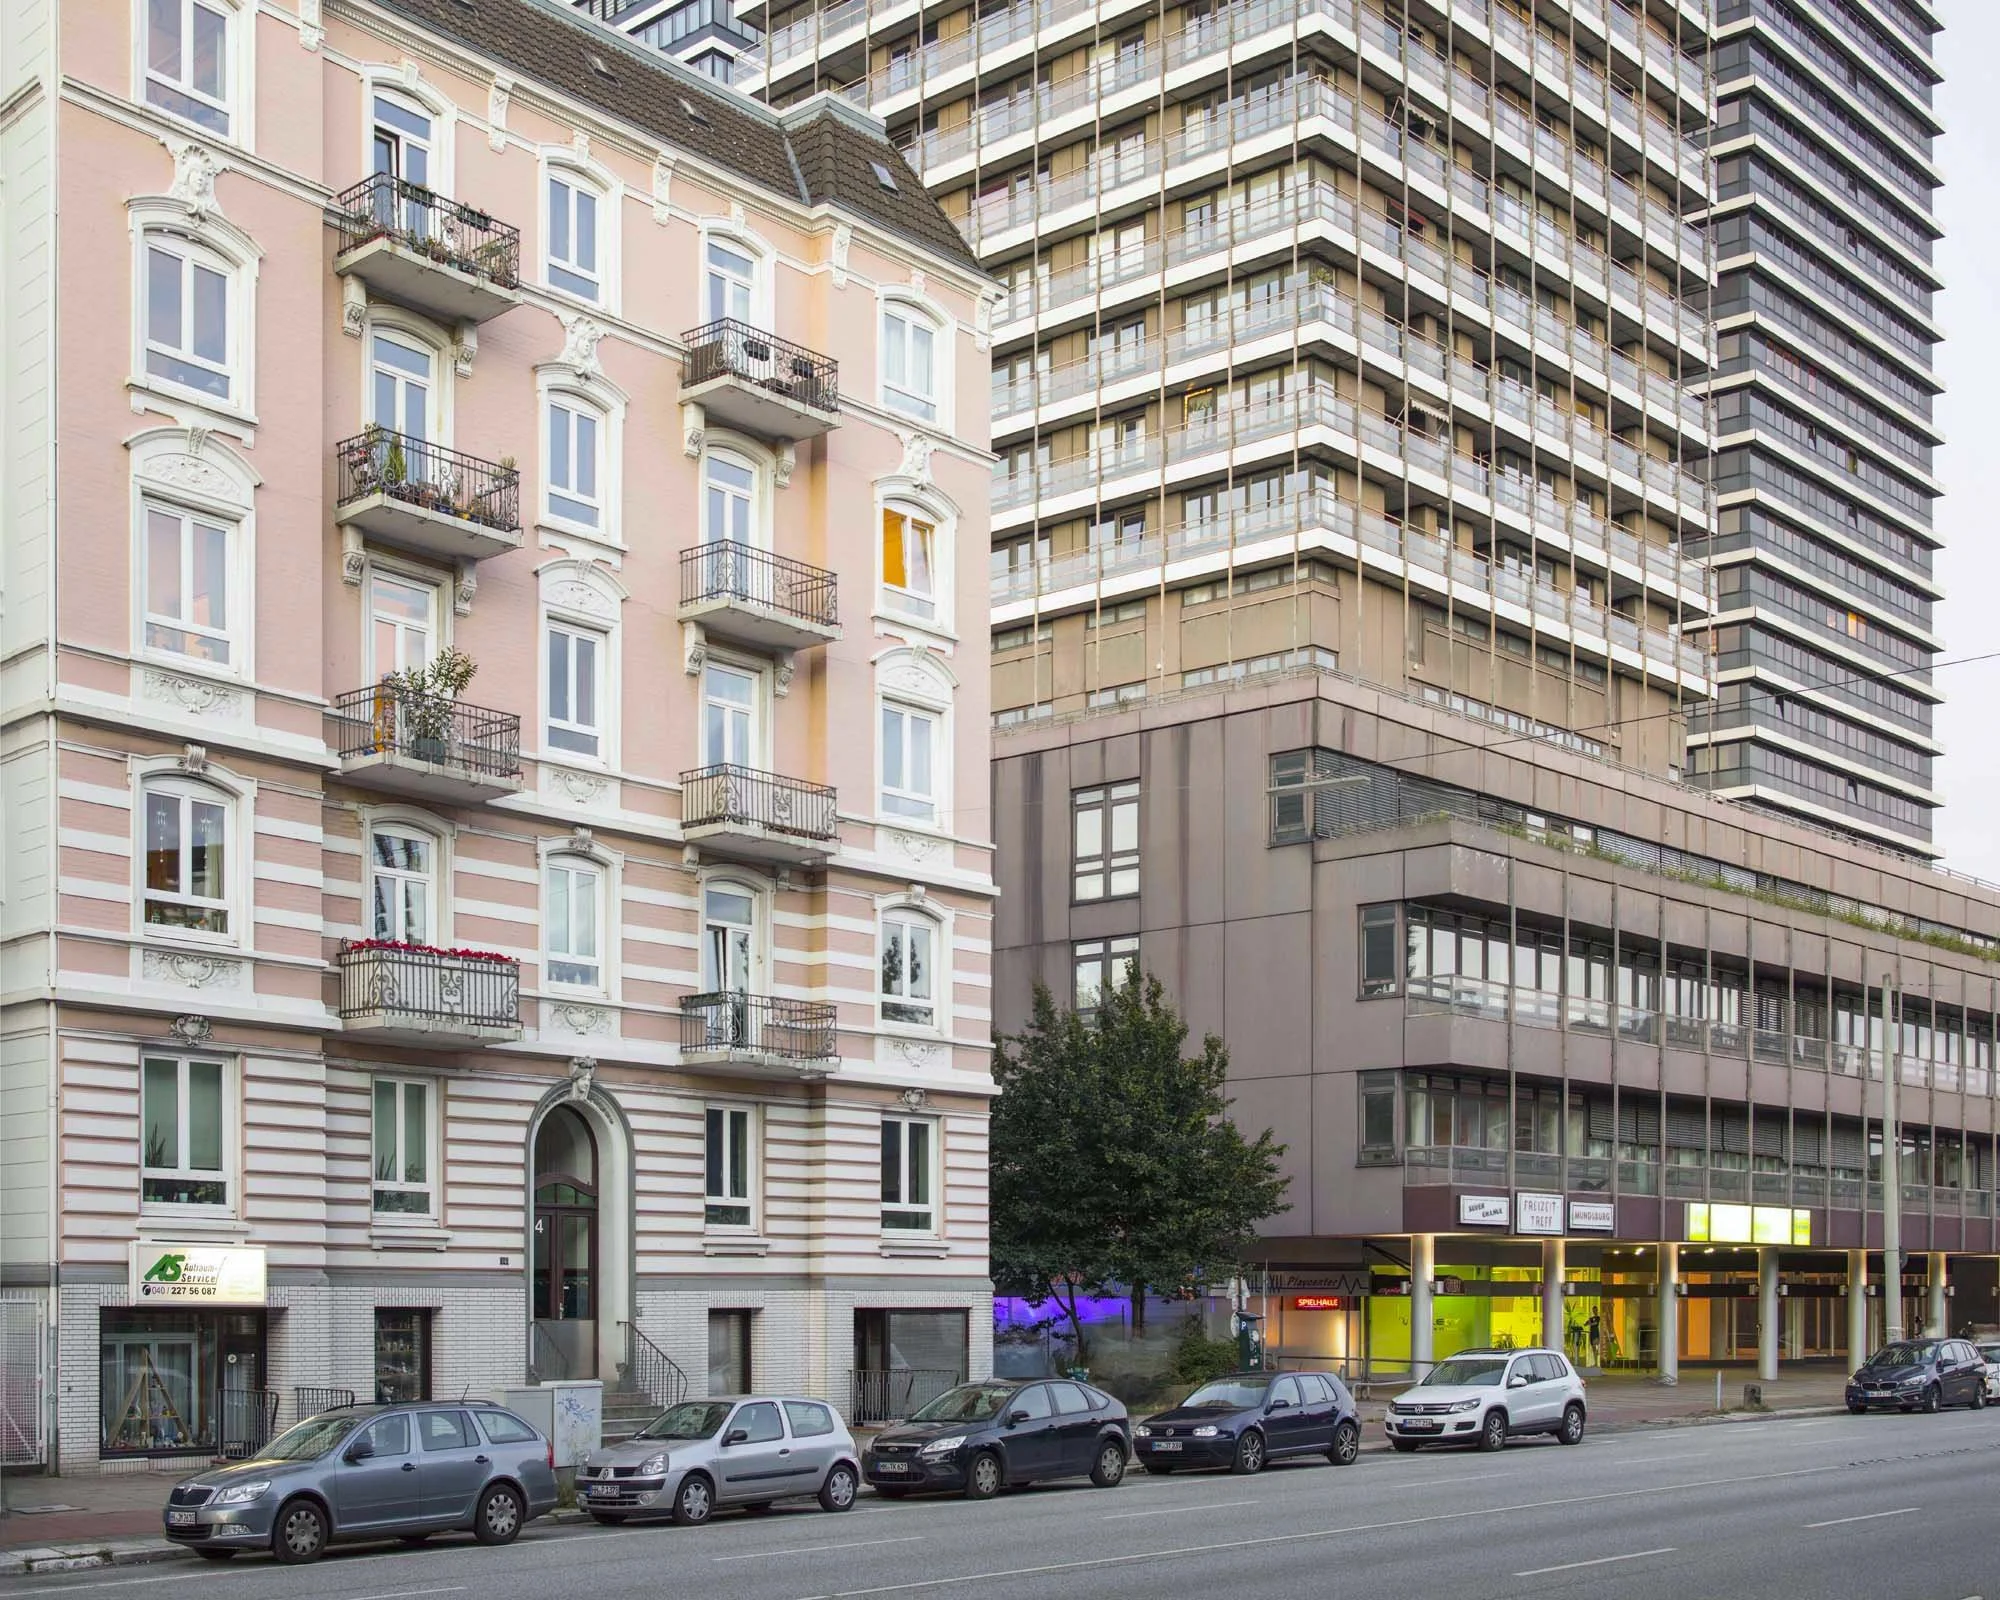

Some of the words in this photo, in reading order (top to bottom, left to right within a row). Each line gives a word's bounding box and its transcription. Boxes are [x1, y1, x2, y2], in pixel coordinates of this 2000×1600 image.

[535, 1219, 544, 1233] 4
[1531, 1215, 1553, 1227] TREFF
[181, 1273, 216, 1283] Service
[151, 1286, 165, 1295] 040
[171, 1286, 187, 1295] 227
[189, 1286, 200, 1295] 56
[201, 1287, 217, 1296] 087
[1297, 1298, 1339, 1307] SPIELHALLE
